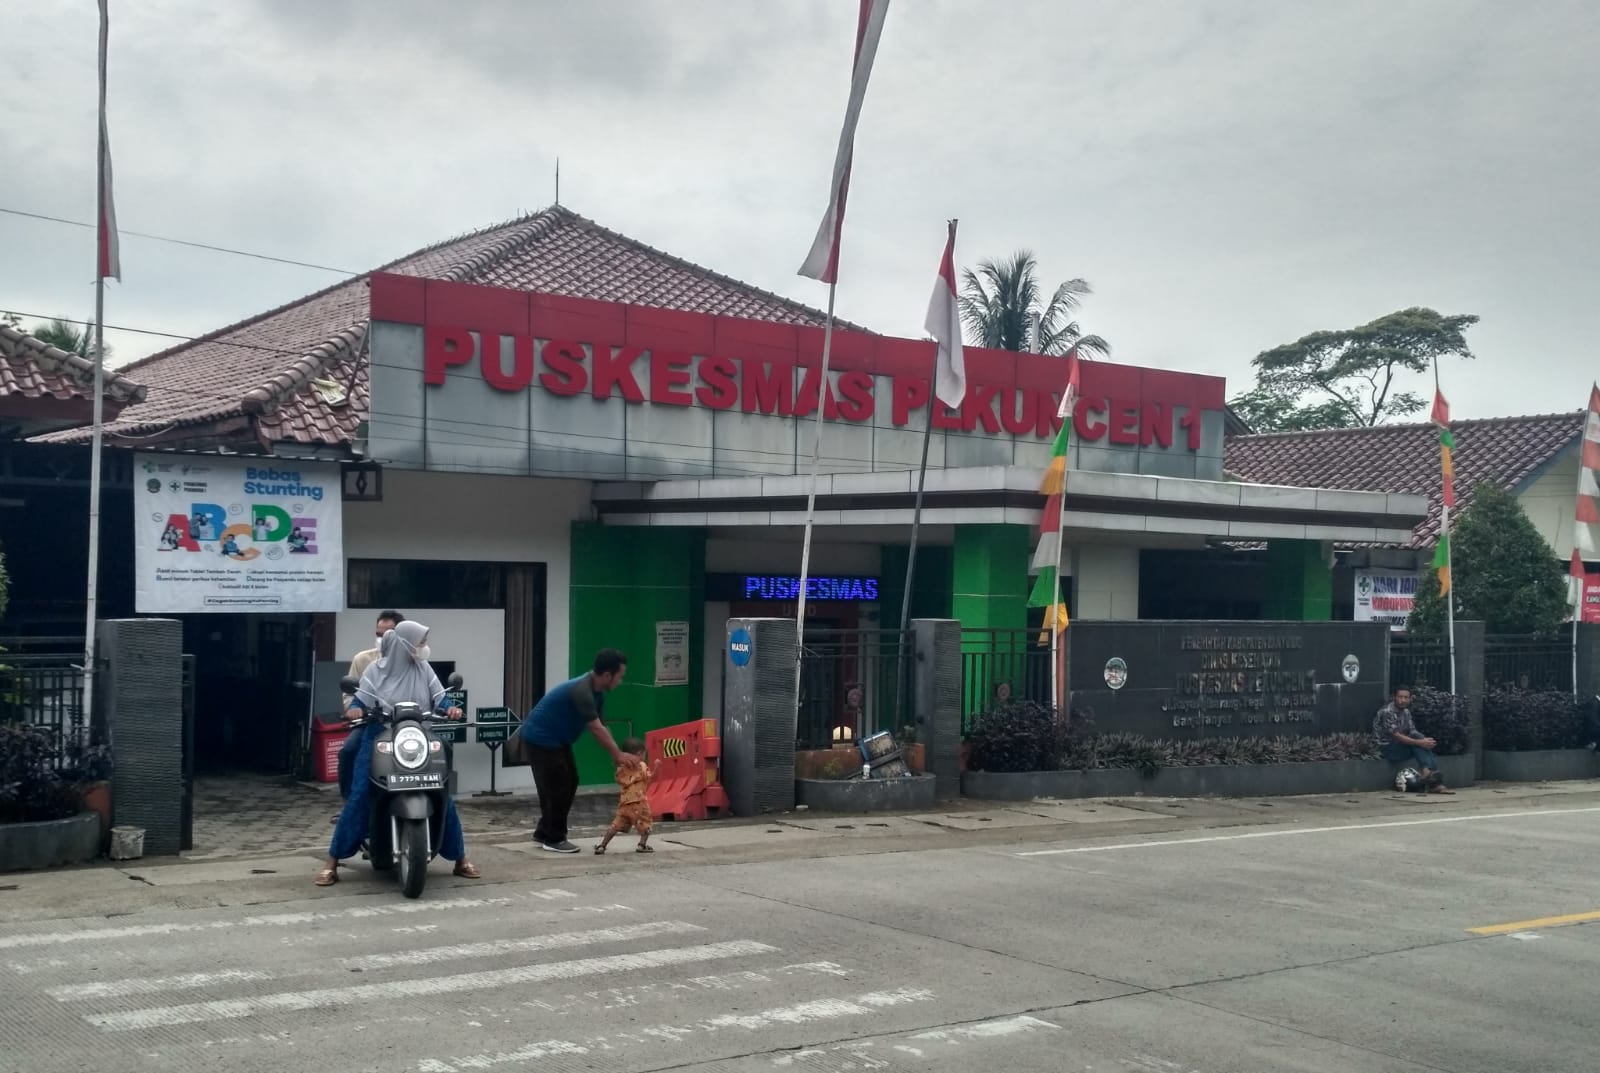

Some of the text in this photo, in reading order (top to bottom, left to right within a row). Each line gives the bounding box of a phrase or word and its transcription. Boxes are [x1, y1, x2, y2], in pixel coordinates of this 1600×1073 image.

[425, 326, 874, 422] PUSKESMAS
[1182, 399, 1201, 450] 1
[246, 467, 300, 481] Bebas
[244, 481, 323, 501] Stunting
[746, 577, 878, 600] PUSKESMAS
[782, 604, 817, 616] UD
[731, 642, 749, 653] MASUK
